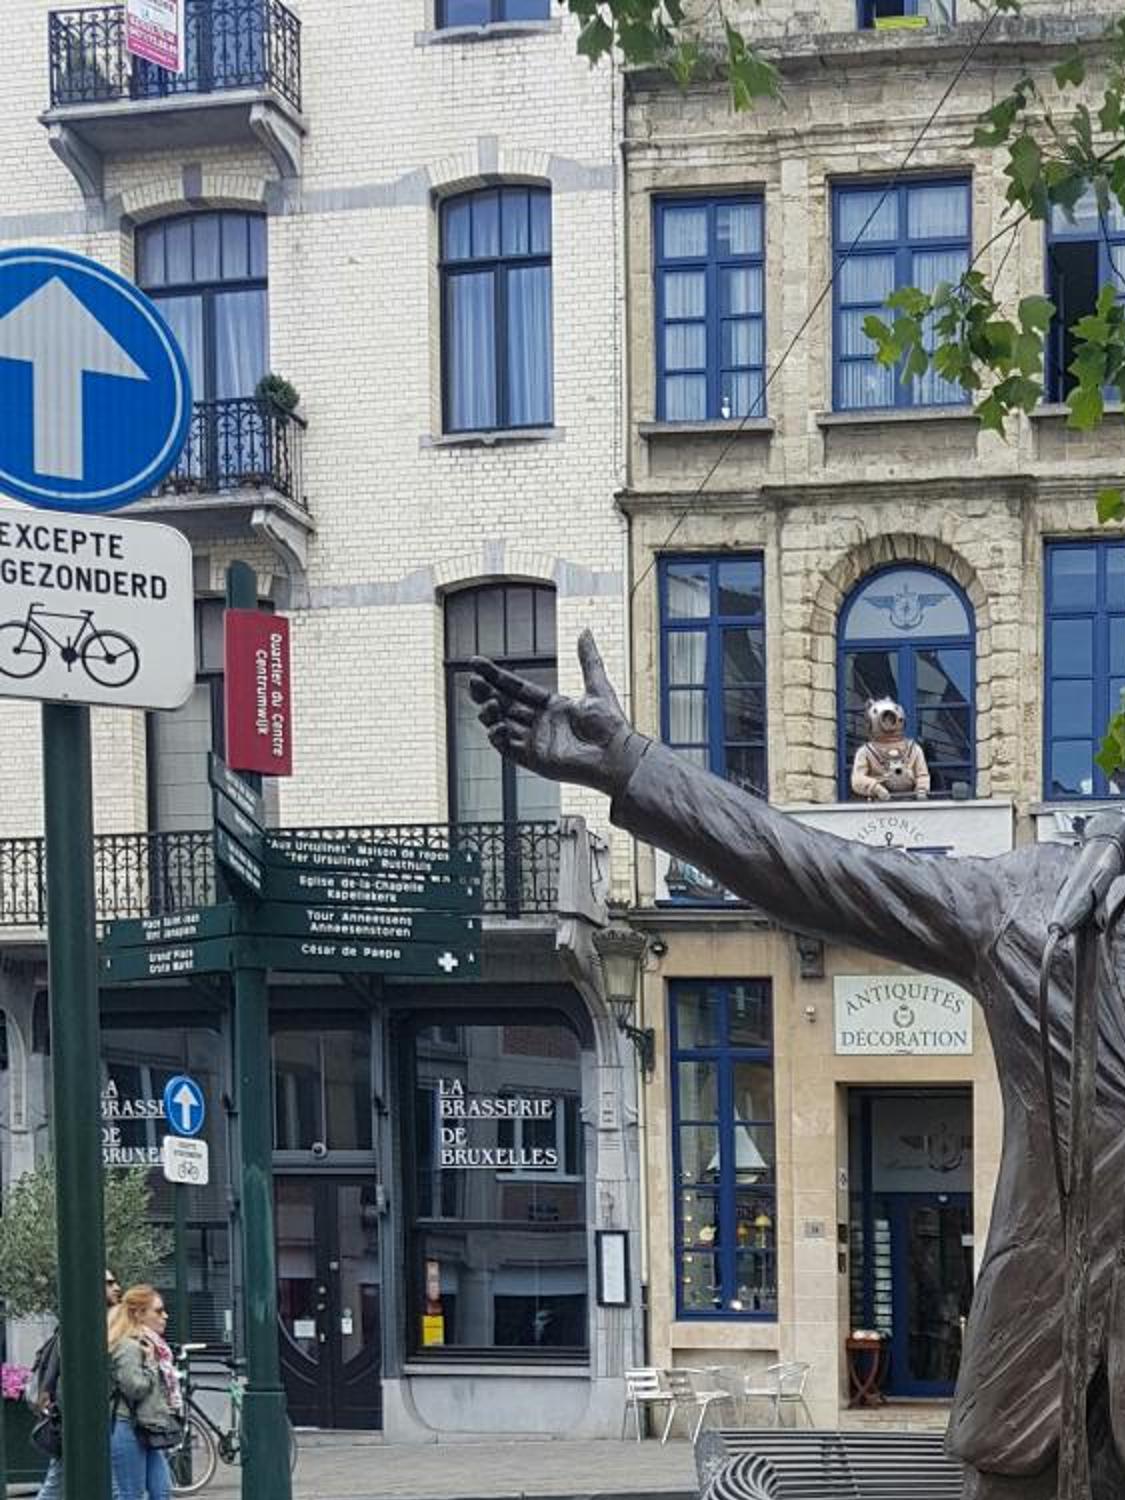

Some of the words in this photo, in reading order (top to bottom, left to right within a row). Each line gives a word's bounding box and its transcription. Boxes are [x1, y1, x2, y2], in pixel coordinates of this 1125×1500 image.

[1, 558, 167, 600] GEZONDERD
[270, 633, 283, 687] Quartier
[256, 649, 269, 735] Centrumwijk
[271, 691, 283, 707] du
[272, 714, 284, 757] Centre
[357, 845, 397, 859] Maison
[401, 848, 415, 859] de
[419, 851, 449, 862] repos
[380, 858, 432, 873] Rusthuis
[327, 889, 397, 903] Kapellekerk
[306, 909, 335, 923] Tour
[341, 912, 413, 927] Anneessens
[301, 943, 336, 956] César
[341, 947, 357, 958] de
[363, 947, 401, 960] Paepe
[440, 1079, 464, 1095] LA
[440, 1099, 553, 1117] BRASSERIE
[440, 1127, 467, 1145] DE
[440, 1148, 558, 1165] BRUXELLES
